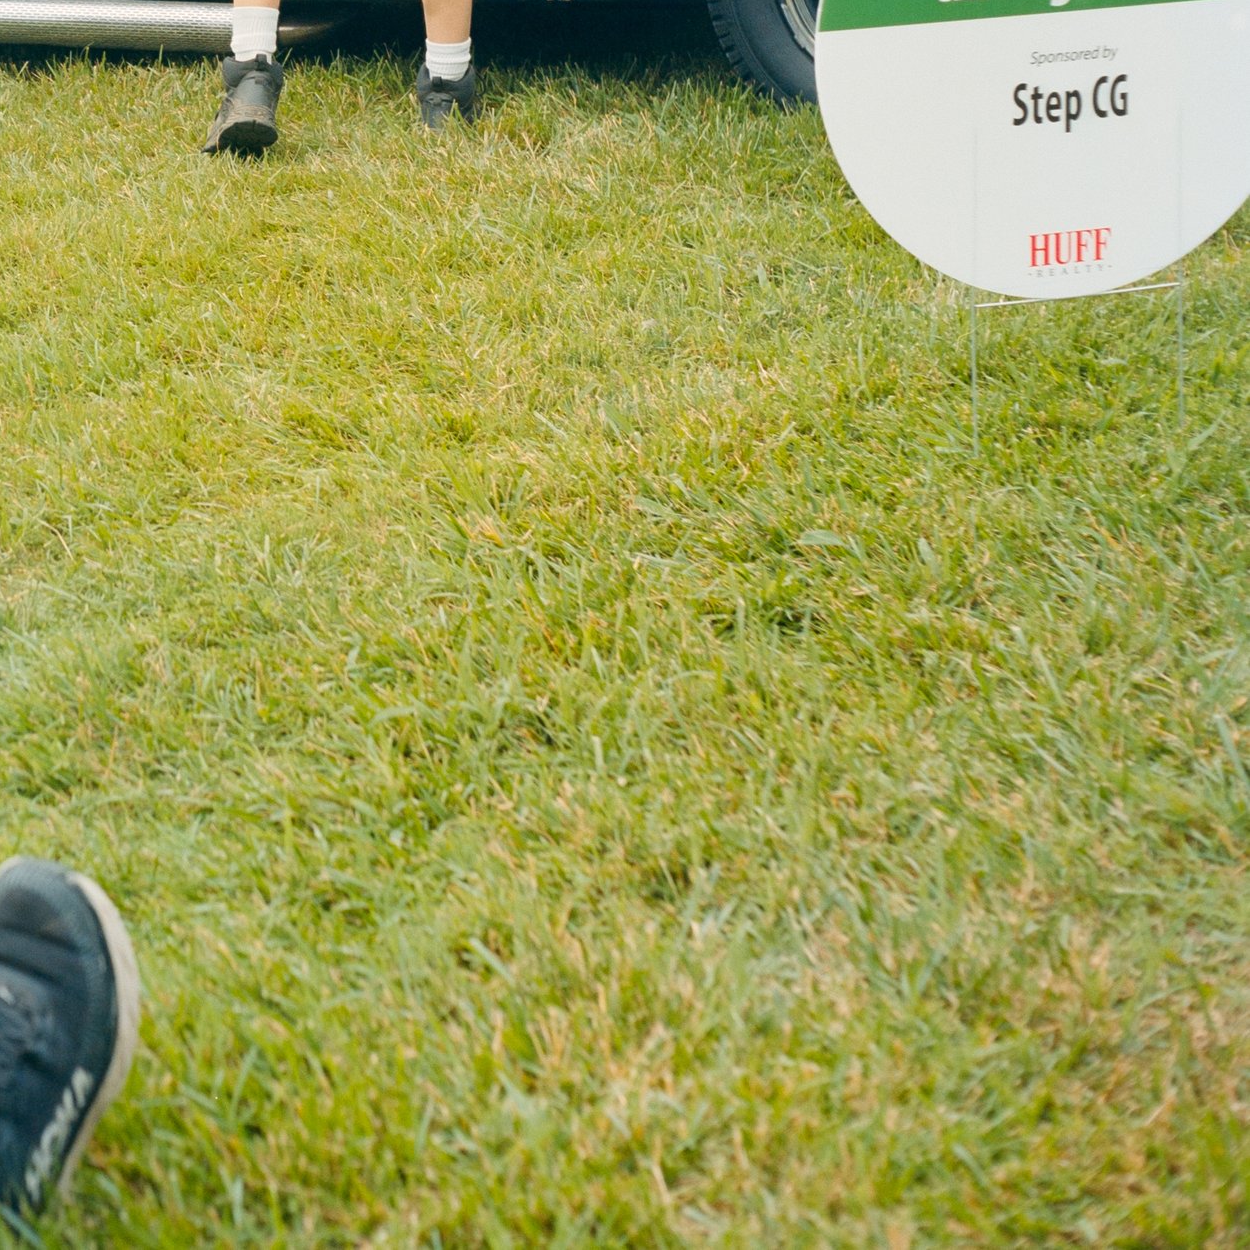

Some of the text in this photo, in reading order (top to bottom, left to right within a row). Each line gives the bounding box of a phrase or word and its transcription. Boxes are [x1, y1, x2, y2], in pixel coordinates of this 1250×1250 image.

[1030, 45, 1118, 67] Sponsored by
[1012, 74, 1129, 134] Step CG
[1029, 227, 1112, 268] HUFF
